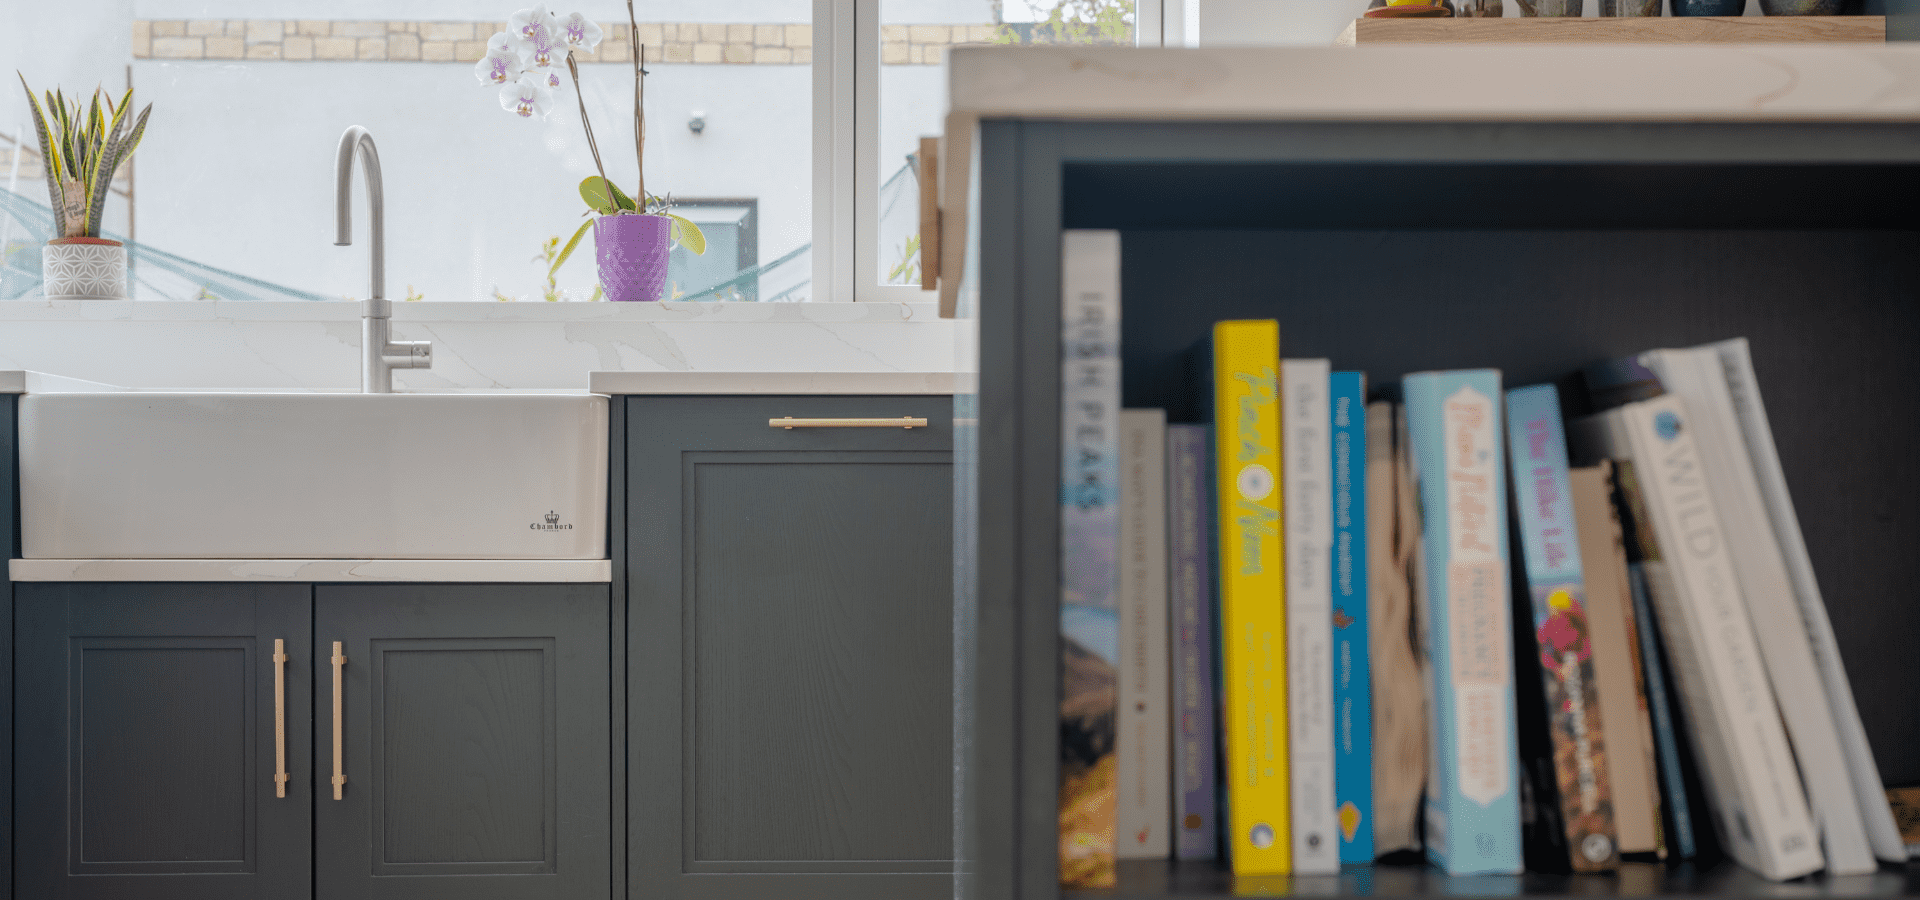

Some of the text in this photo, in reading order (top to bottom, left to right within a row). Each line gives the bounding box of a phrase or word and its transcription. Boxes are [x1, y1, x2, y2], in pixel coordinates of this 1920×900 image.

[1076, 291, 1105, 510] IRISH PEAKS
[1234, 366, 1277, 462] Pinch
[1662, 444, 1720, 560] WILD
